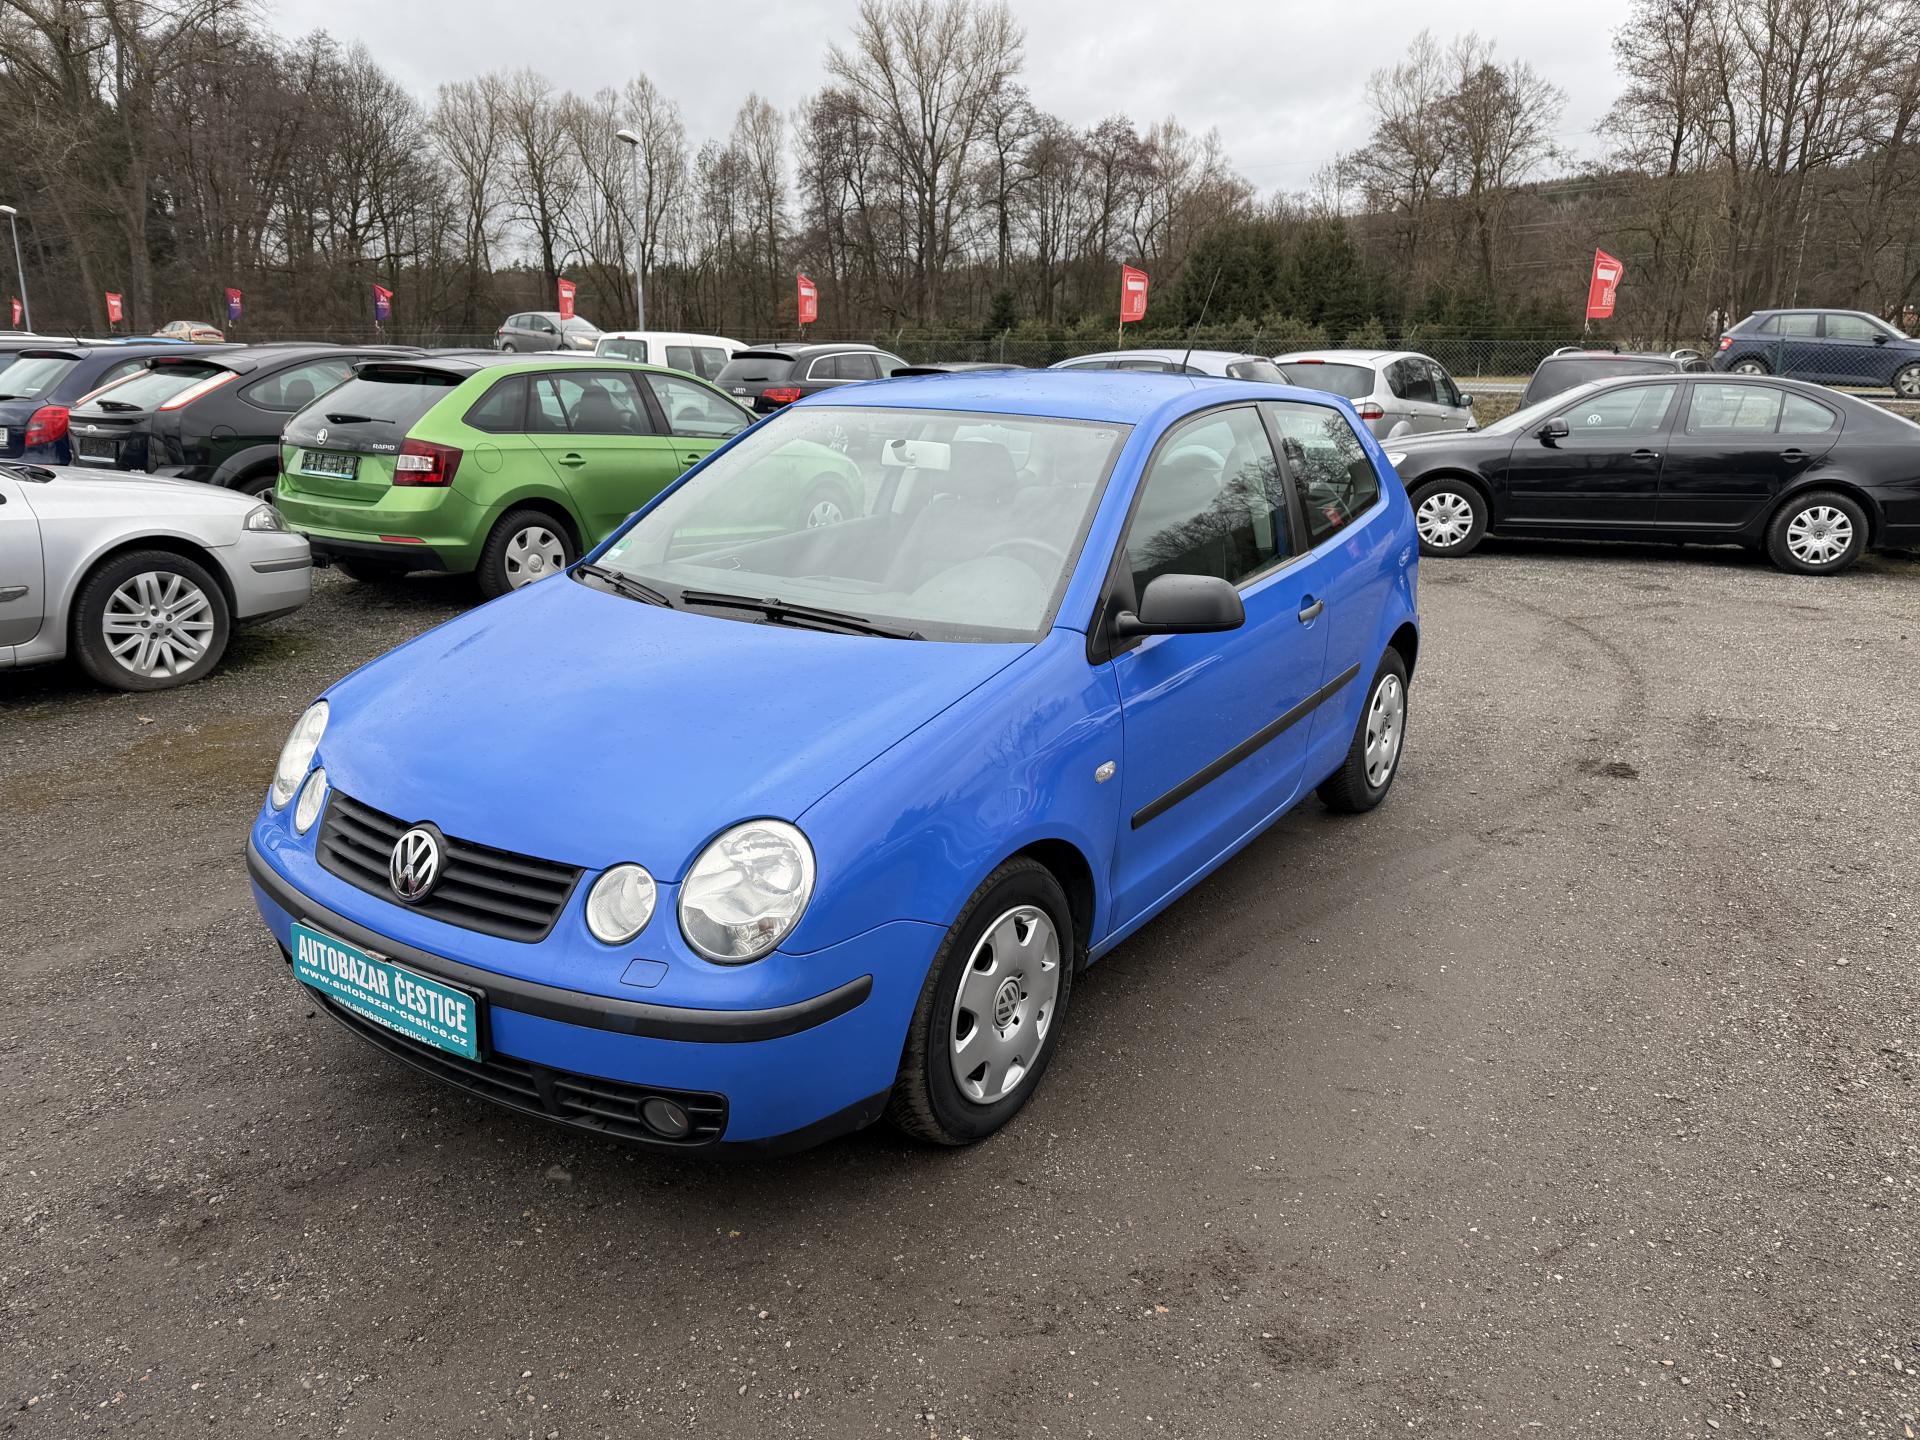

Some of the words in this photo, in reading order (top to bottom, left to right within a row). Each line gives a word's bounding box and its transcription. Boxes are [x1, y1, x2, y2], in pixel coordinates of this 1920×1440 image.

[372, 443, 396, 451] RAPID
[298, 934, 390, 999] AUTOBAZAR
[394, 971, 468, 1033] ČESTICE
[299, 965, 468, 1047] www.autobazar-cestice.cz
